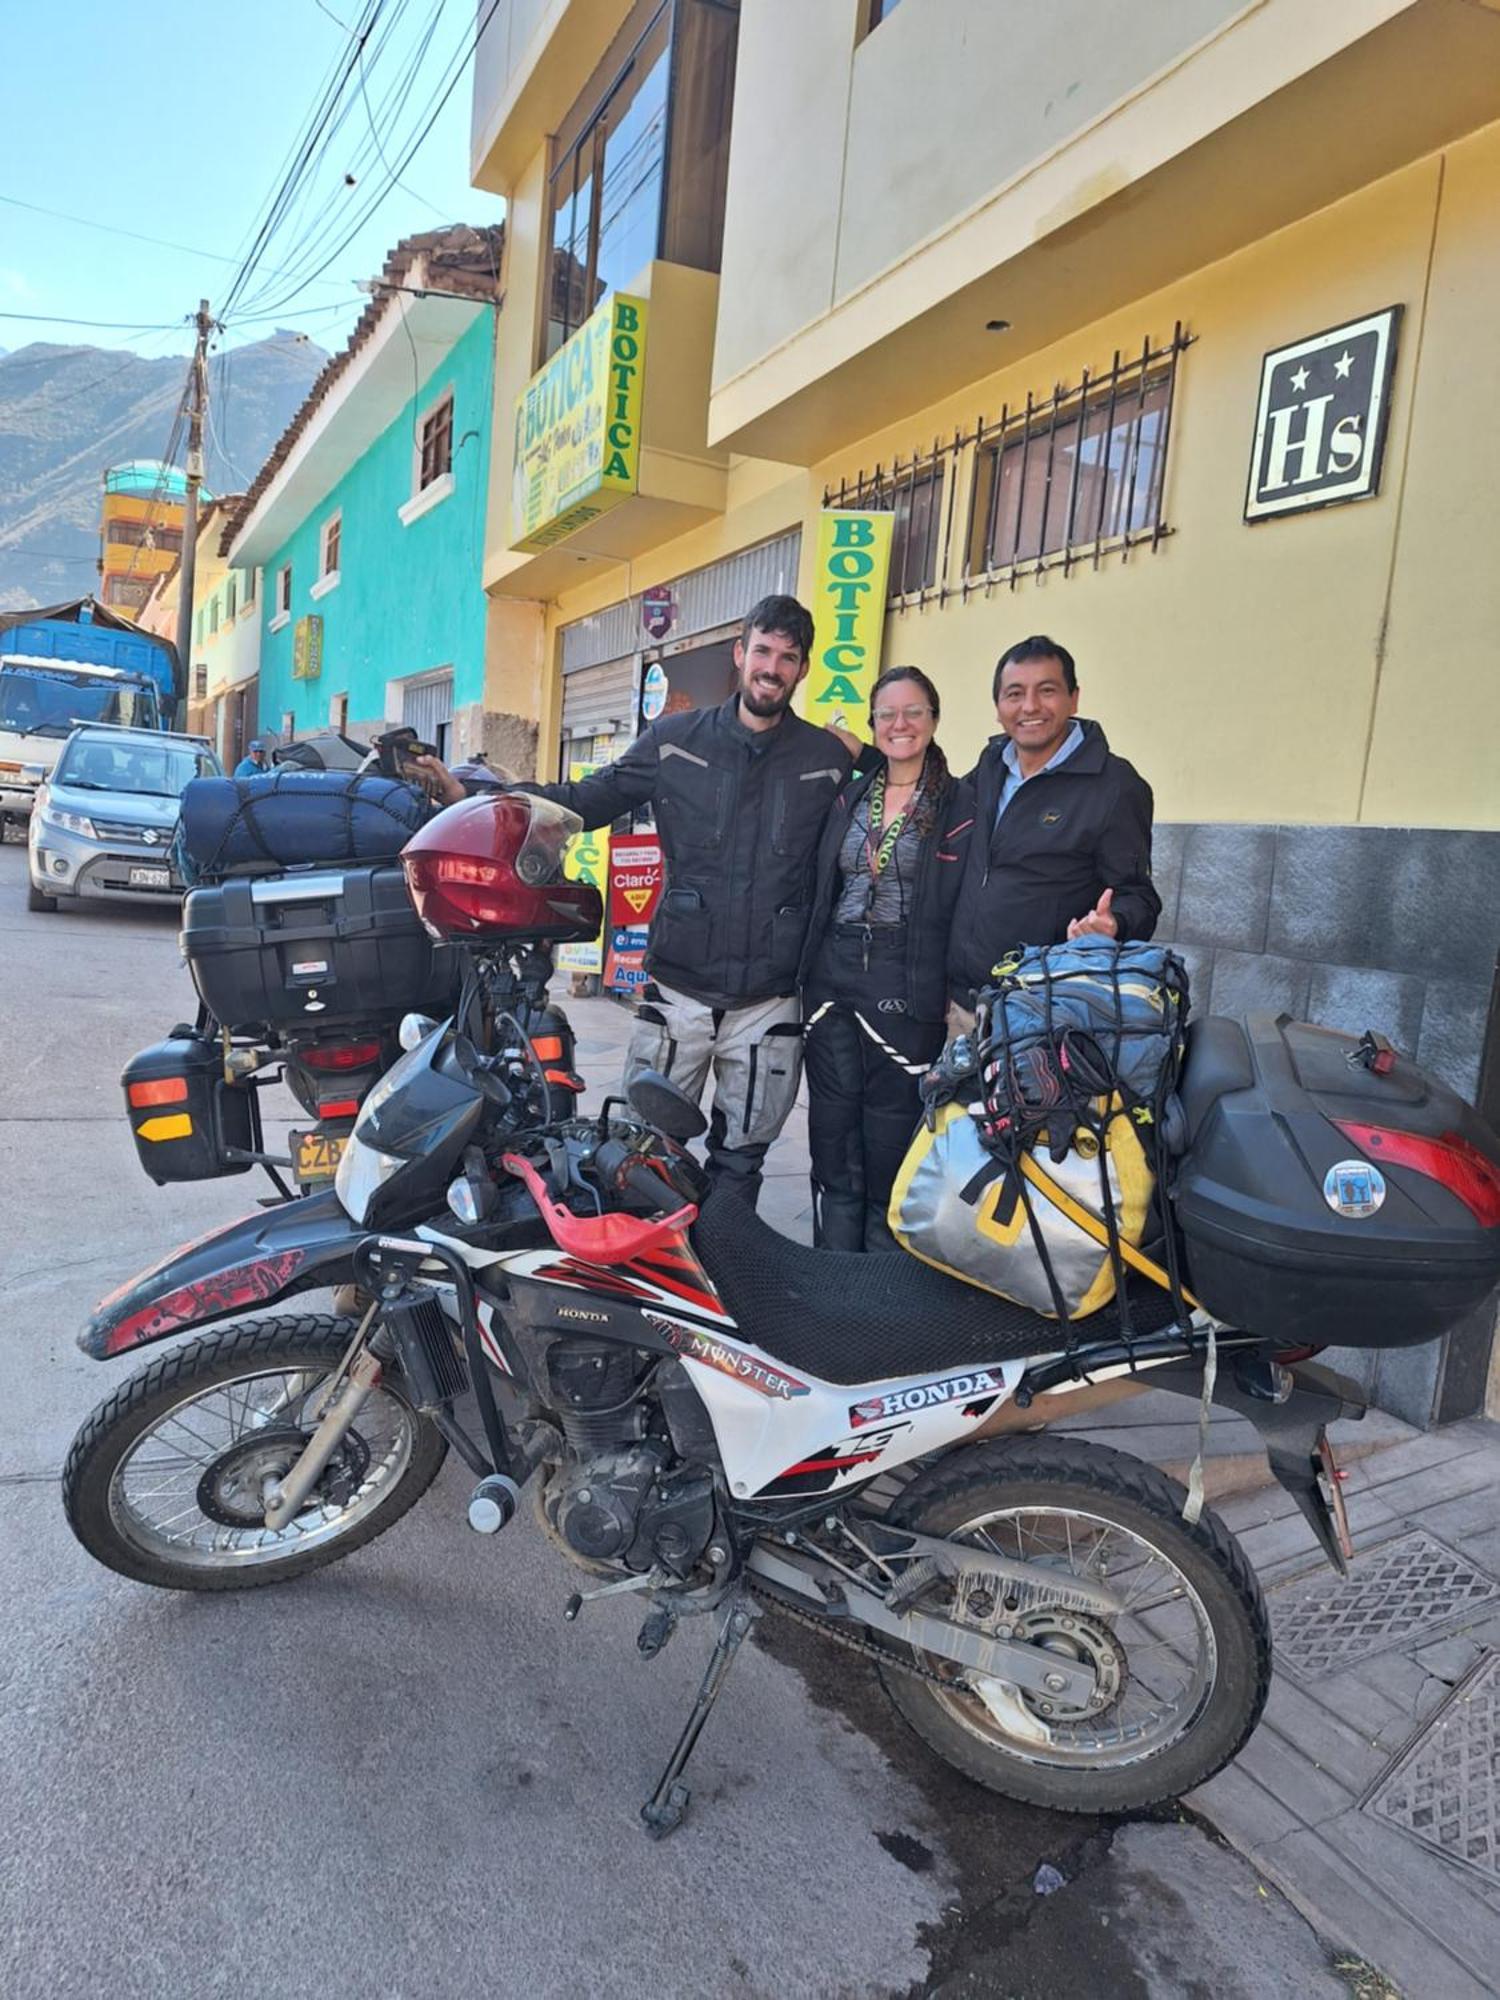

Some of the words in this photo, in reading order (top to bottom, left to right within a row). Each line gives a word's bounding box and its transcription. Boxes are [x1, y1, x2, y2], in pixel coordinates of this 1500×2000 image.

[603, 302, 639, 480] BOTICA
[1259, 394, 1362, 493] Hs
[815, 519, 875, 703] BOTICA
[877, 812, 907, 874] ONDA
[614, 873, 654, 888] Claro
[559, 1308, 609, 1322] HONDA
[691, 1338, 792, 1399] MONSTER
[881, 1372, 998, 1415] HONDA
